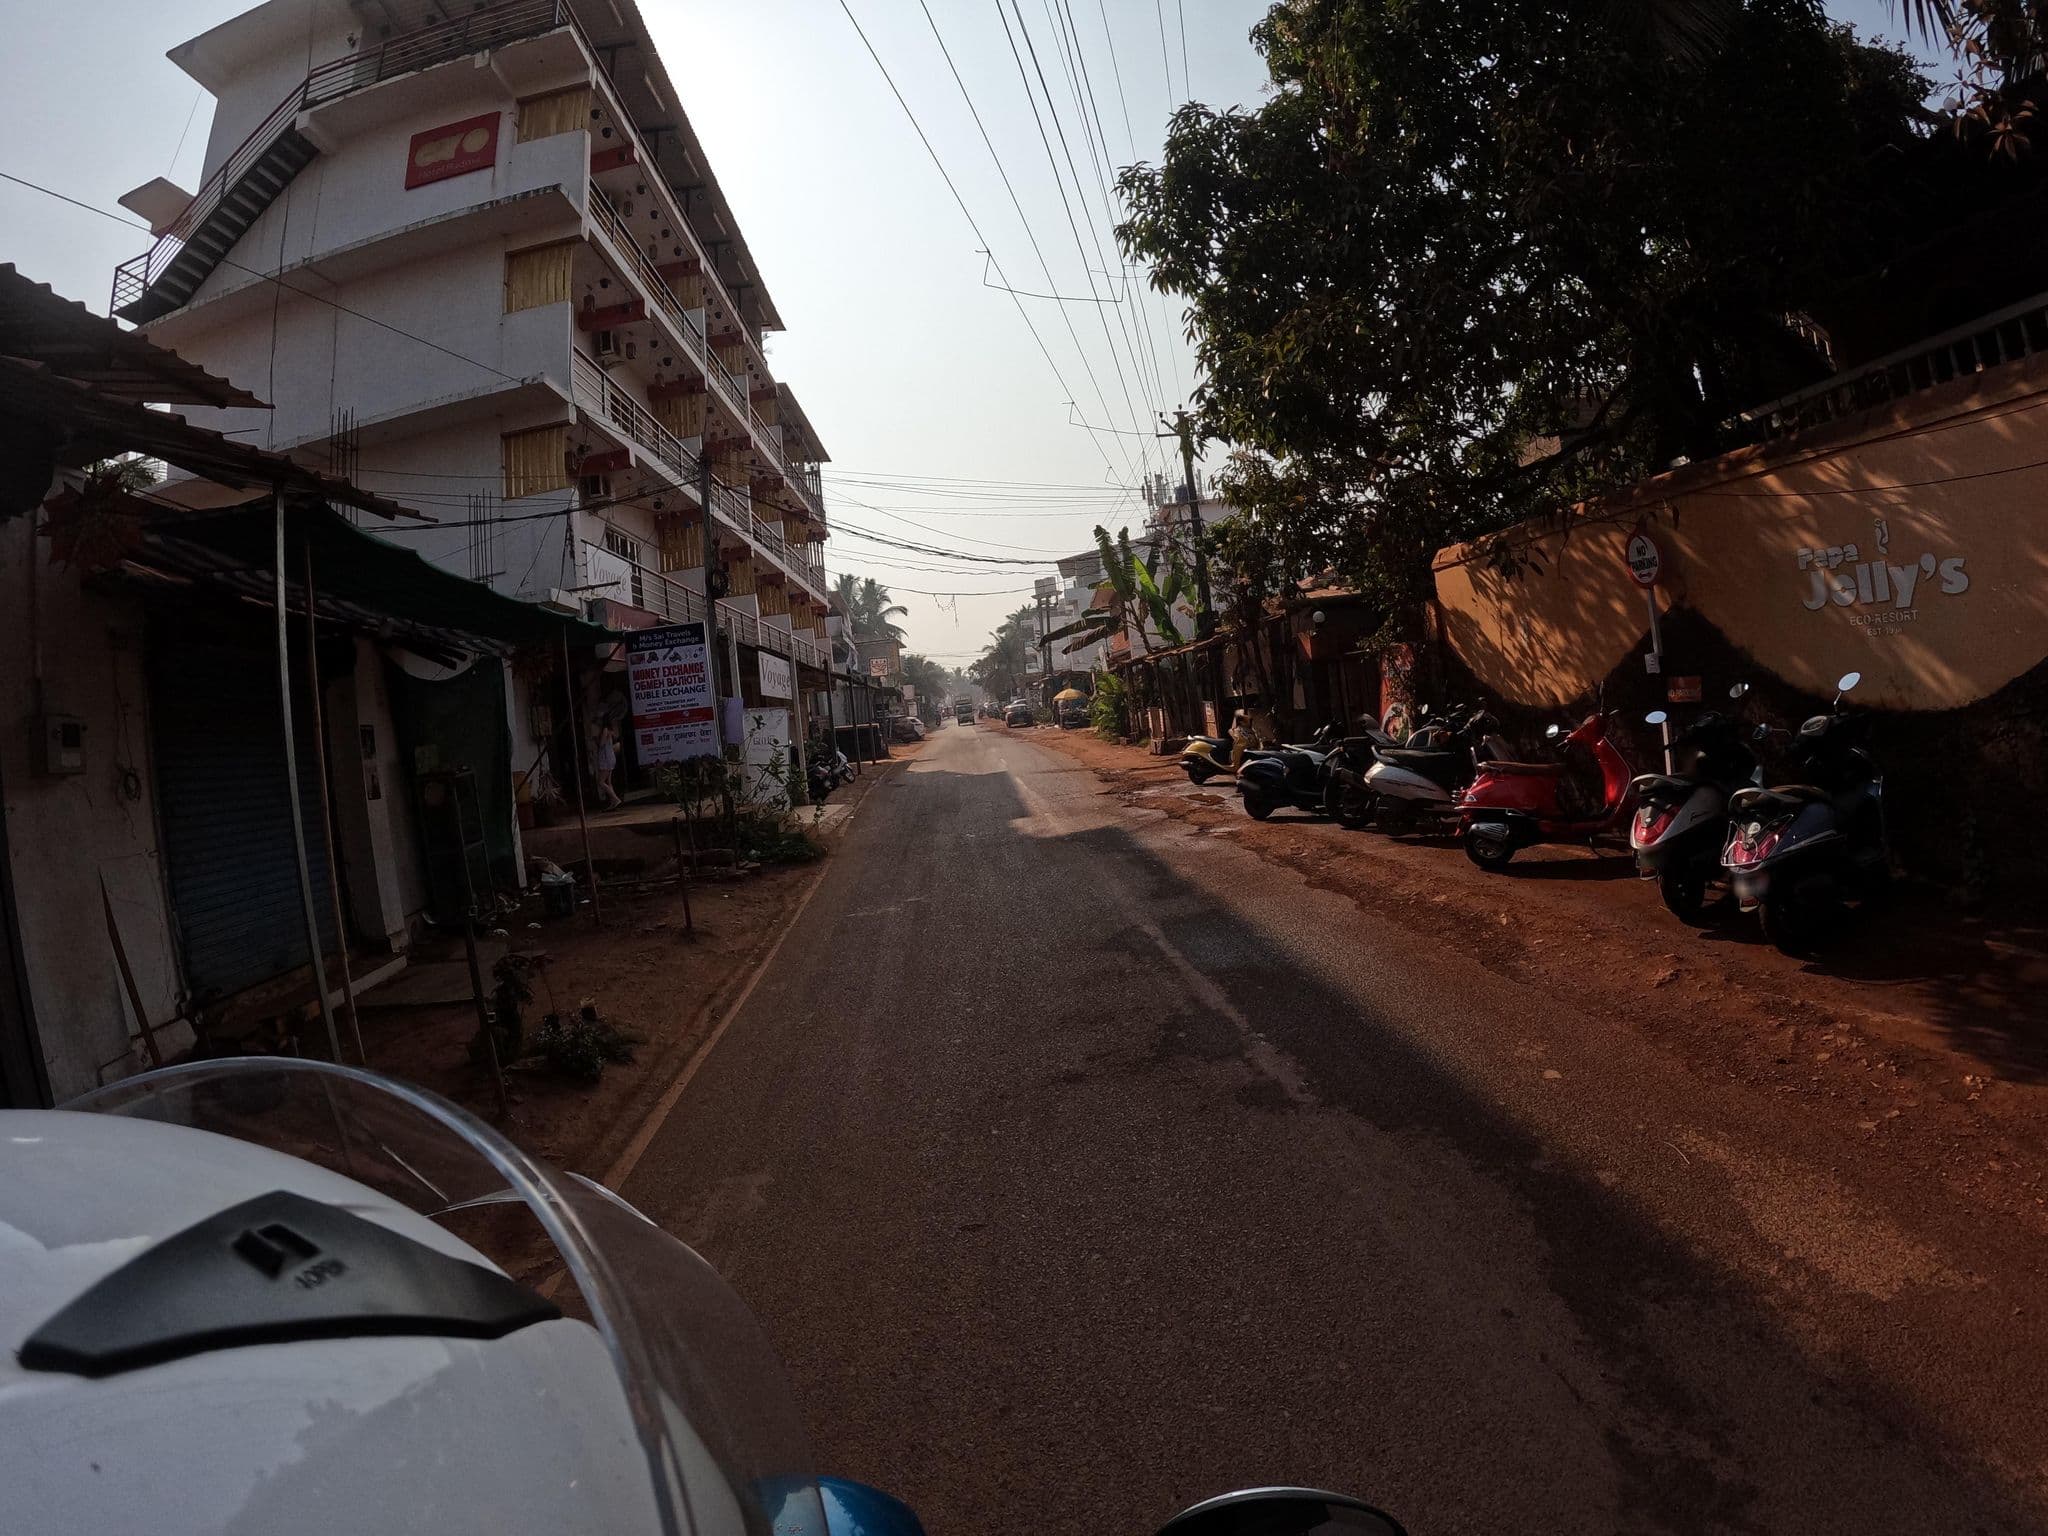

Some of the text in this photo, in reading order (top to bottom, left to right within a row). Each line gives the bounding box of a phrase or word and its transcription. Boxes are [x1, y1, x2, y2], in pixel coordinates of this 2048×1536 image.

[1636, 545, 1646, 556] NO
[1797, 543, 1860, 570] Papa
[1632, 557, 1658, 572] PARKING
[1802, 552, 1969, 610] Jolly's
[1849, 610, 1920, 626] ECO-RESORT
[665, 637, 700, 645] Exchange
[666, 630, 691, 638] Travels
[632, 662, 704, 680] MONEY EXCHANGE
[760, 658, 791, 691] Voyage
[634, 674, 706, 690] ОБМЕН ВАЛЮТЫ
[635, 685, 706, 700] RUBLE EXCHANGE
